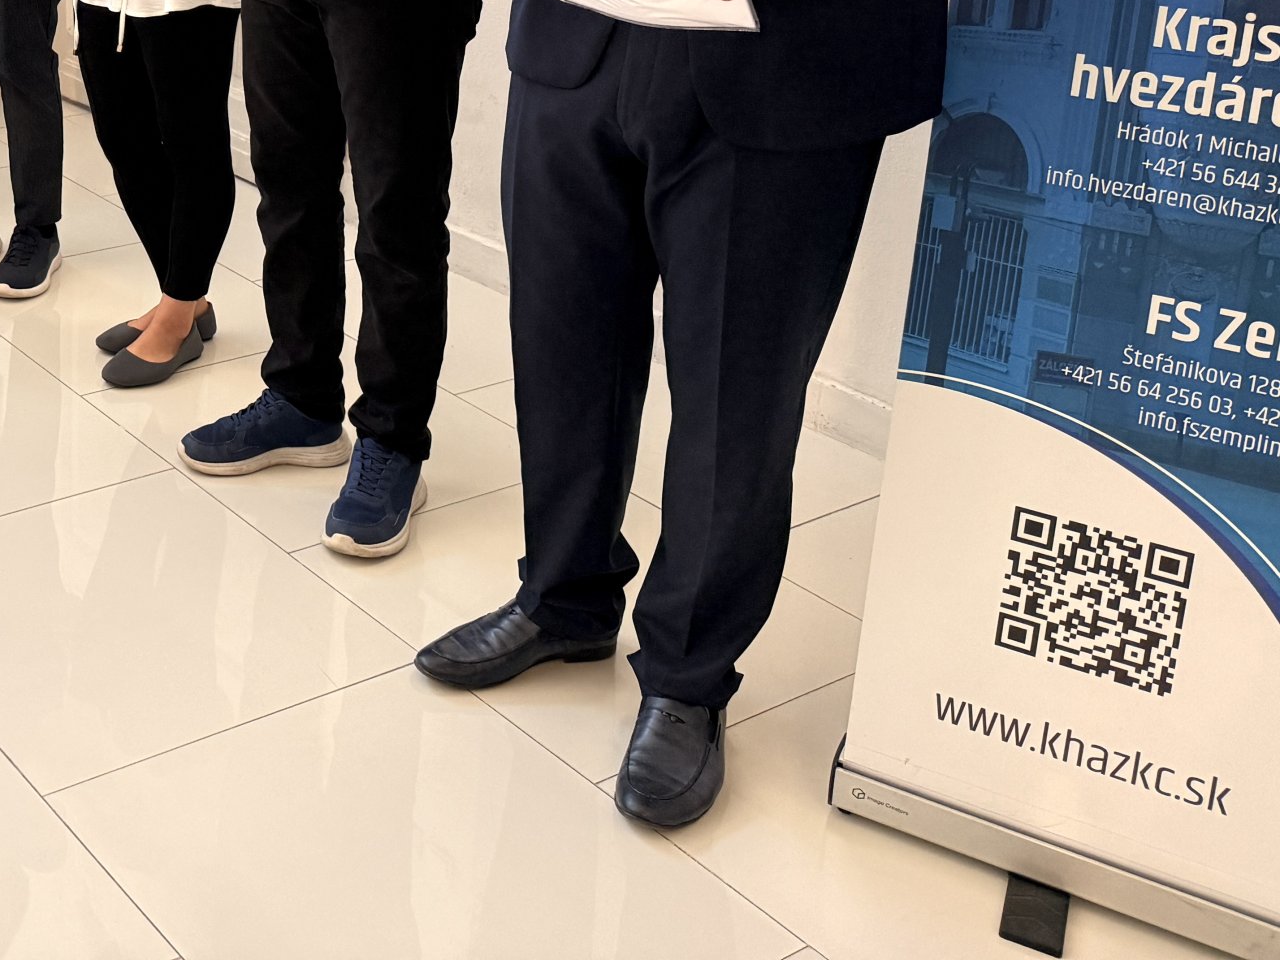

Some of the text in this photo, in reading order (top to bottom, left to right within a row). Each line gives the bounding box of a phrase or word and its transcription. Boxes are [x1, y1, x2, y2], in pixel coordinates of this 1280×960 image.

[1153, 5, 1280, 67] Krajs
[1117, 121, 1280, 164] Hrádok 1 Michal
[1046, 166, 1280, 225] info.hvezdaren@khazk
[1141, 157, 1280, 194] +421 56 644 3
[1146, 294, 1280, 362] FS Ze
[1061, 365, 1103, 387] +421
[1107, 375, 1132, 393] 56
[1137, 380, 1162, 400] 64
[1166, 386, 1202, 409] 256
[1208, 395, 1236, 420] 03,
[1122, 344, 1280, 398] Štefánikova 128
[935, 693, 1232, 815] www.khazkc.sk
